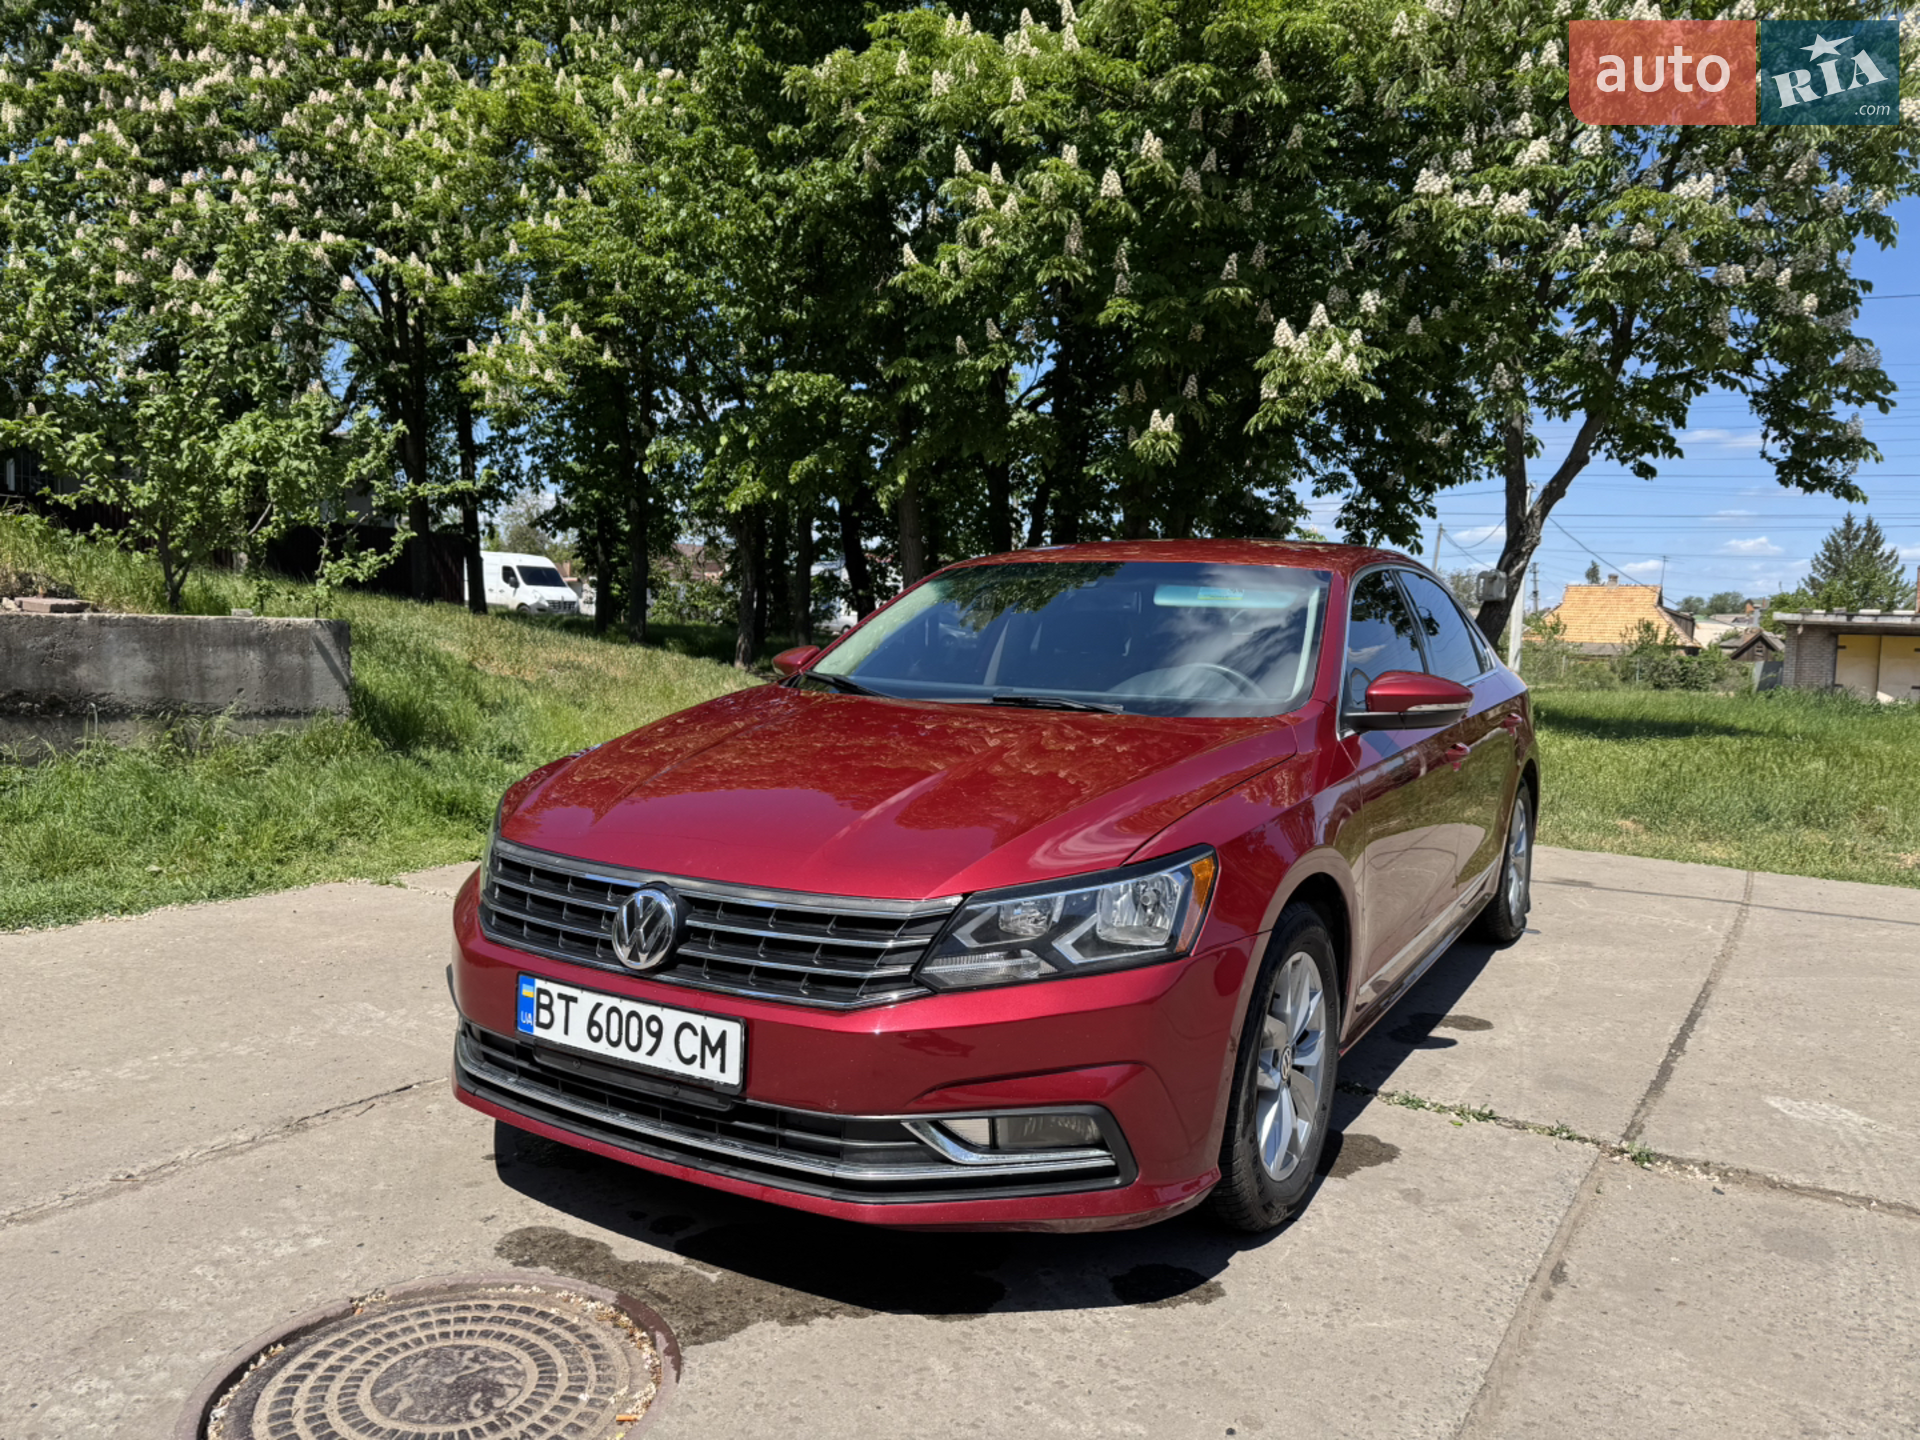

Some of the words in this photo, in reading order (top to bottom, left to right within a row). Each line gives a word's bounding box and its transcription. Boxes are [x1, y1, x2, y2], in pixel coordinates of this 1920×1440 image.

[520, 1010, 533, 1027] UA
[535, 986, 578, 1037] BT
[586, 1002, 663, 1057] 6009
[674, 1021, 727, 1074] CM
